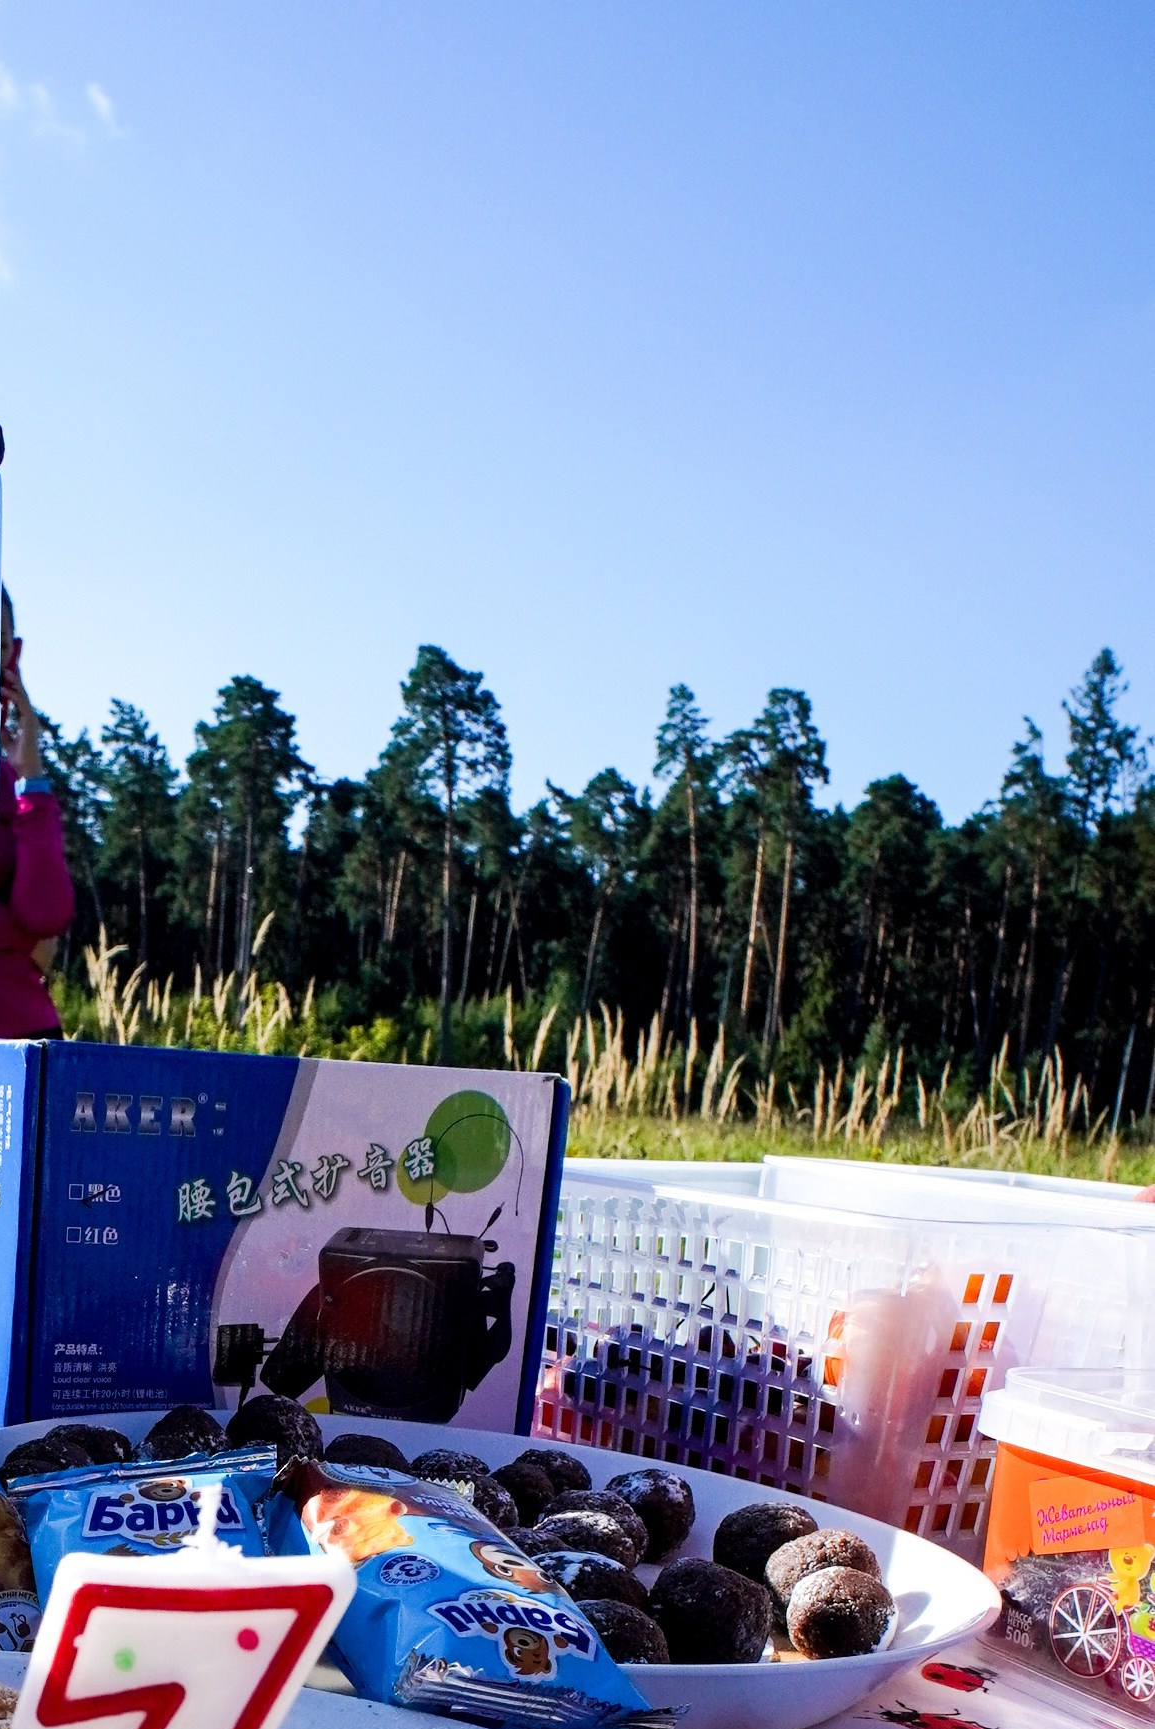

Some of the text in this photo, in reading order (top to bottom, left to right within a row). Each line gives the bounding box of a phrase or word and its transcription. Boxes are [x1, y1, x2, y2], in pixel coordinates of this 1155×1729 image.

[177, 1137, 435, 1223] 腰包式扩音器
[84, 1226, 119, 1245] 红色
[1042, 1516, 1108, 1547] Мармелад
[435, 1602, 591, 1654] Барни
